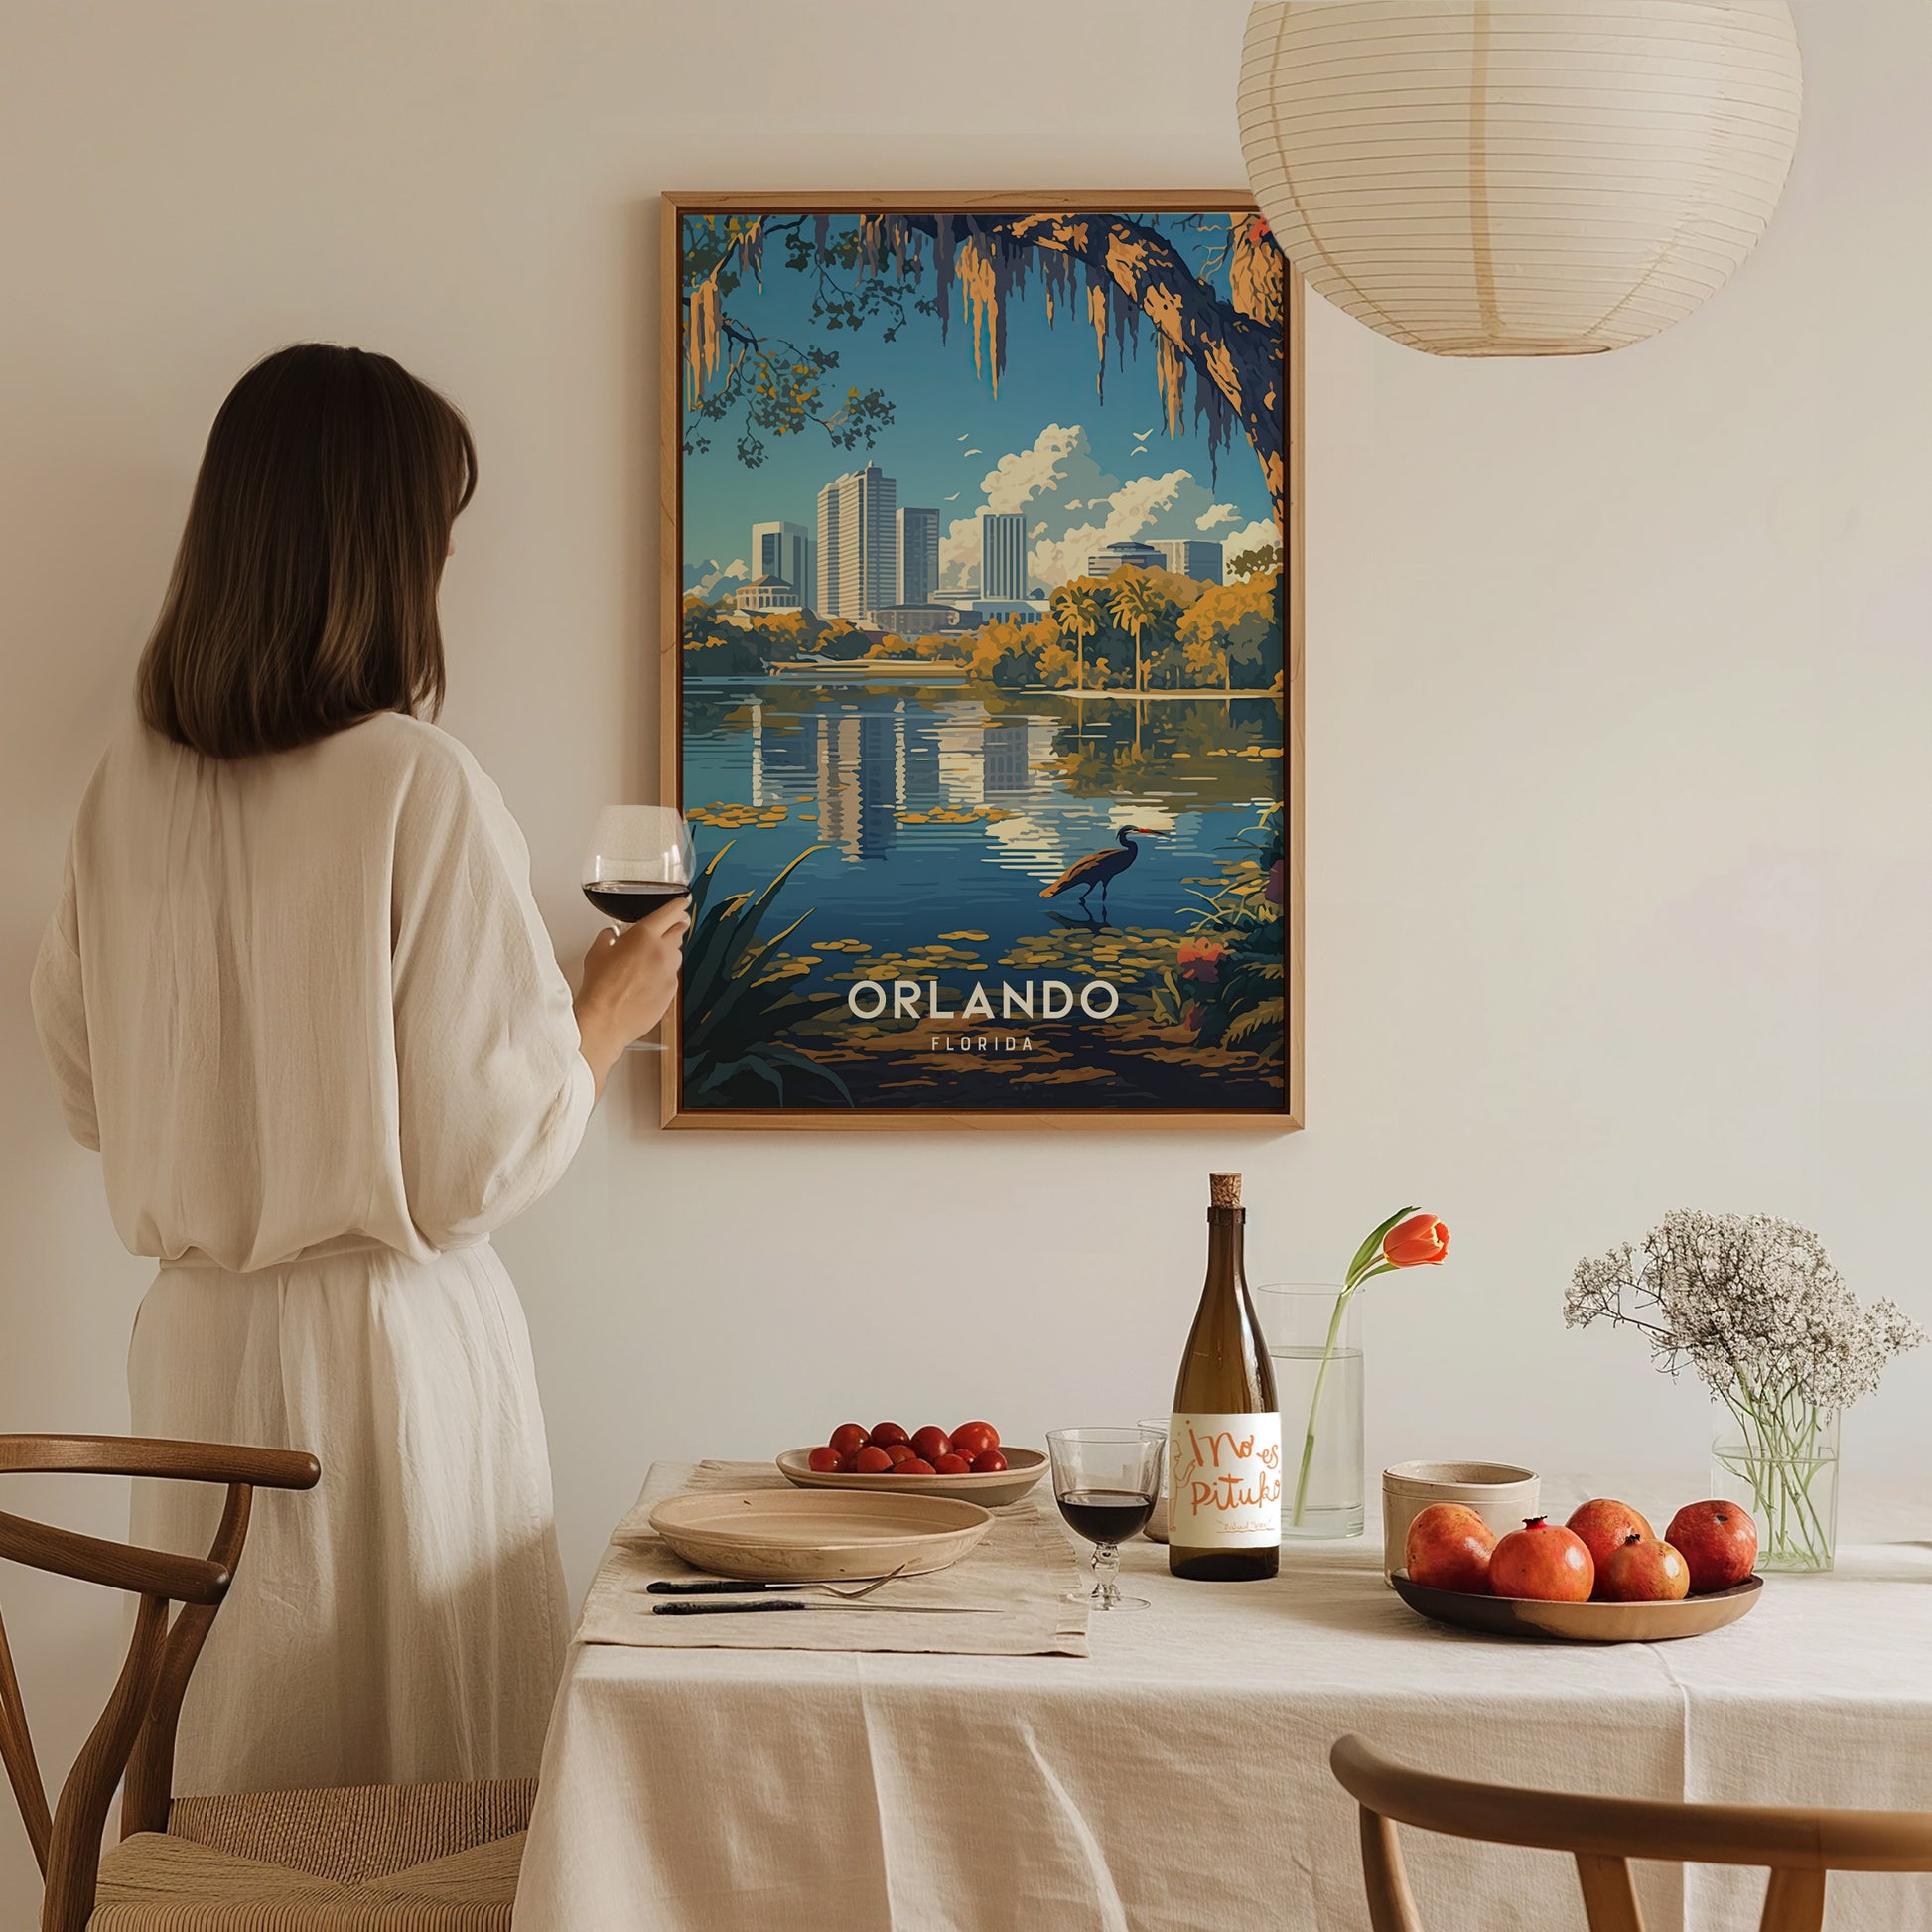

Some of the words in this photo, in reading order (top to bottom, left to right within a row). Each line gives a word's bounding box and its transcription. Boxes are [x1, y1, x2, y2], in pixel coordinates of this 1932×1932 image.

[848, 980, 1119, 1019] ORLANDO
[931, 1036, 1033, 1051] FLORIDA
[1256, 1444, 1279, 1470] es
